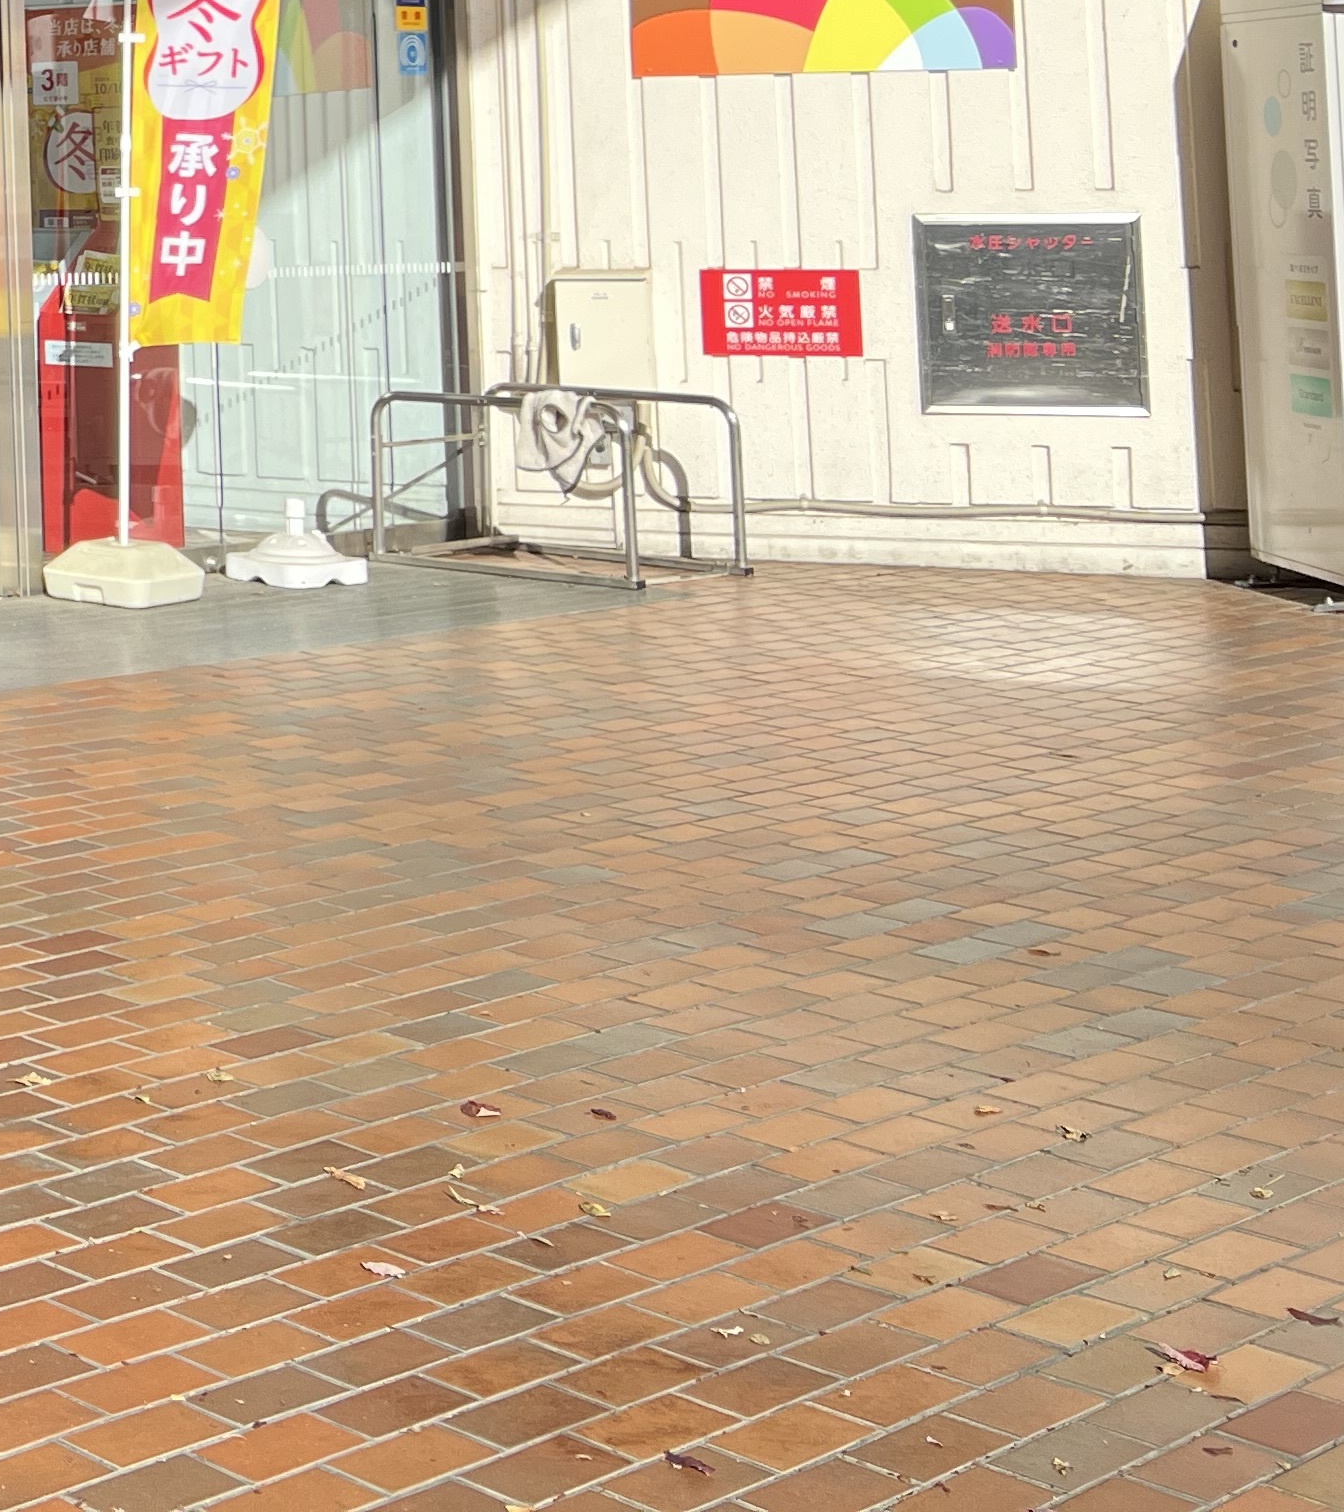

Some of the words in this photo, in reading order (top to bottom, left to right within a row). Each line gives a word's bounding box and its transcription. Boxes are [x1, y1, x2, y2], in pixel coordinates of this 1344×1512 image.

[158, 42, 249, 80] ギフト
[1298, 42, 1324, 219] 証明写真
[160, 133, 219, 277] 承り中
[757, 291, 775, 299] NO
[785, 291, 837, 299] SMOKING
[758, 304, 837, 319] 火気厳禁
[758, 319, 774, 327] NO
[776, 319, 804, 327] OPEN
[807, 319, 839, 327] FLAME
[990, 313, 1073, 334] 送水口
[726, 331, 839, 344] 危険物品持込厳禁
[726, 343, 742, 351] NO
[744, 343, 804, 352] DANGEROUS
[805, 343, 841, 352] GOODS
[985, 340, 1077, 359] 消防隊専用
